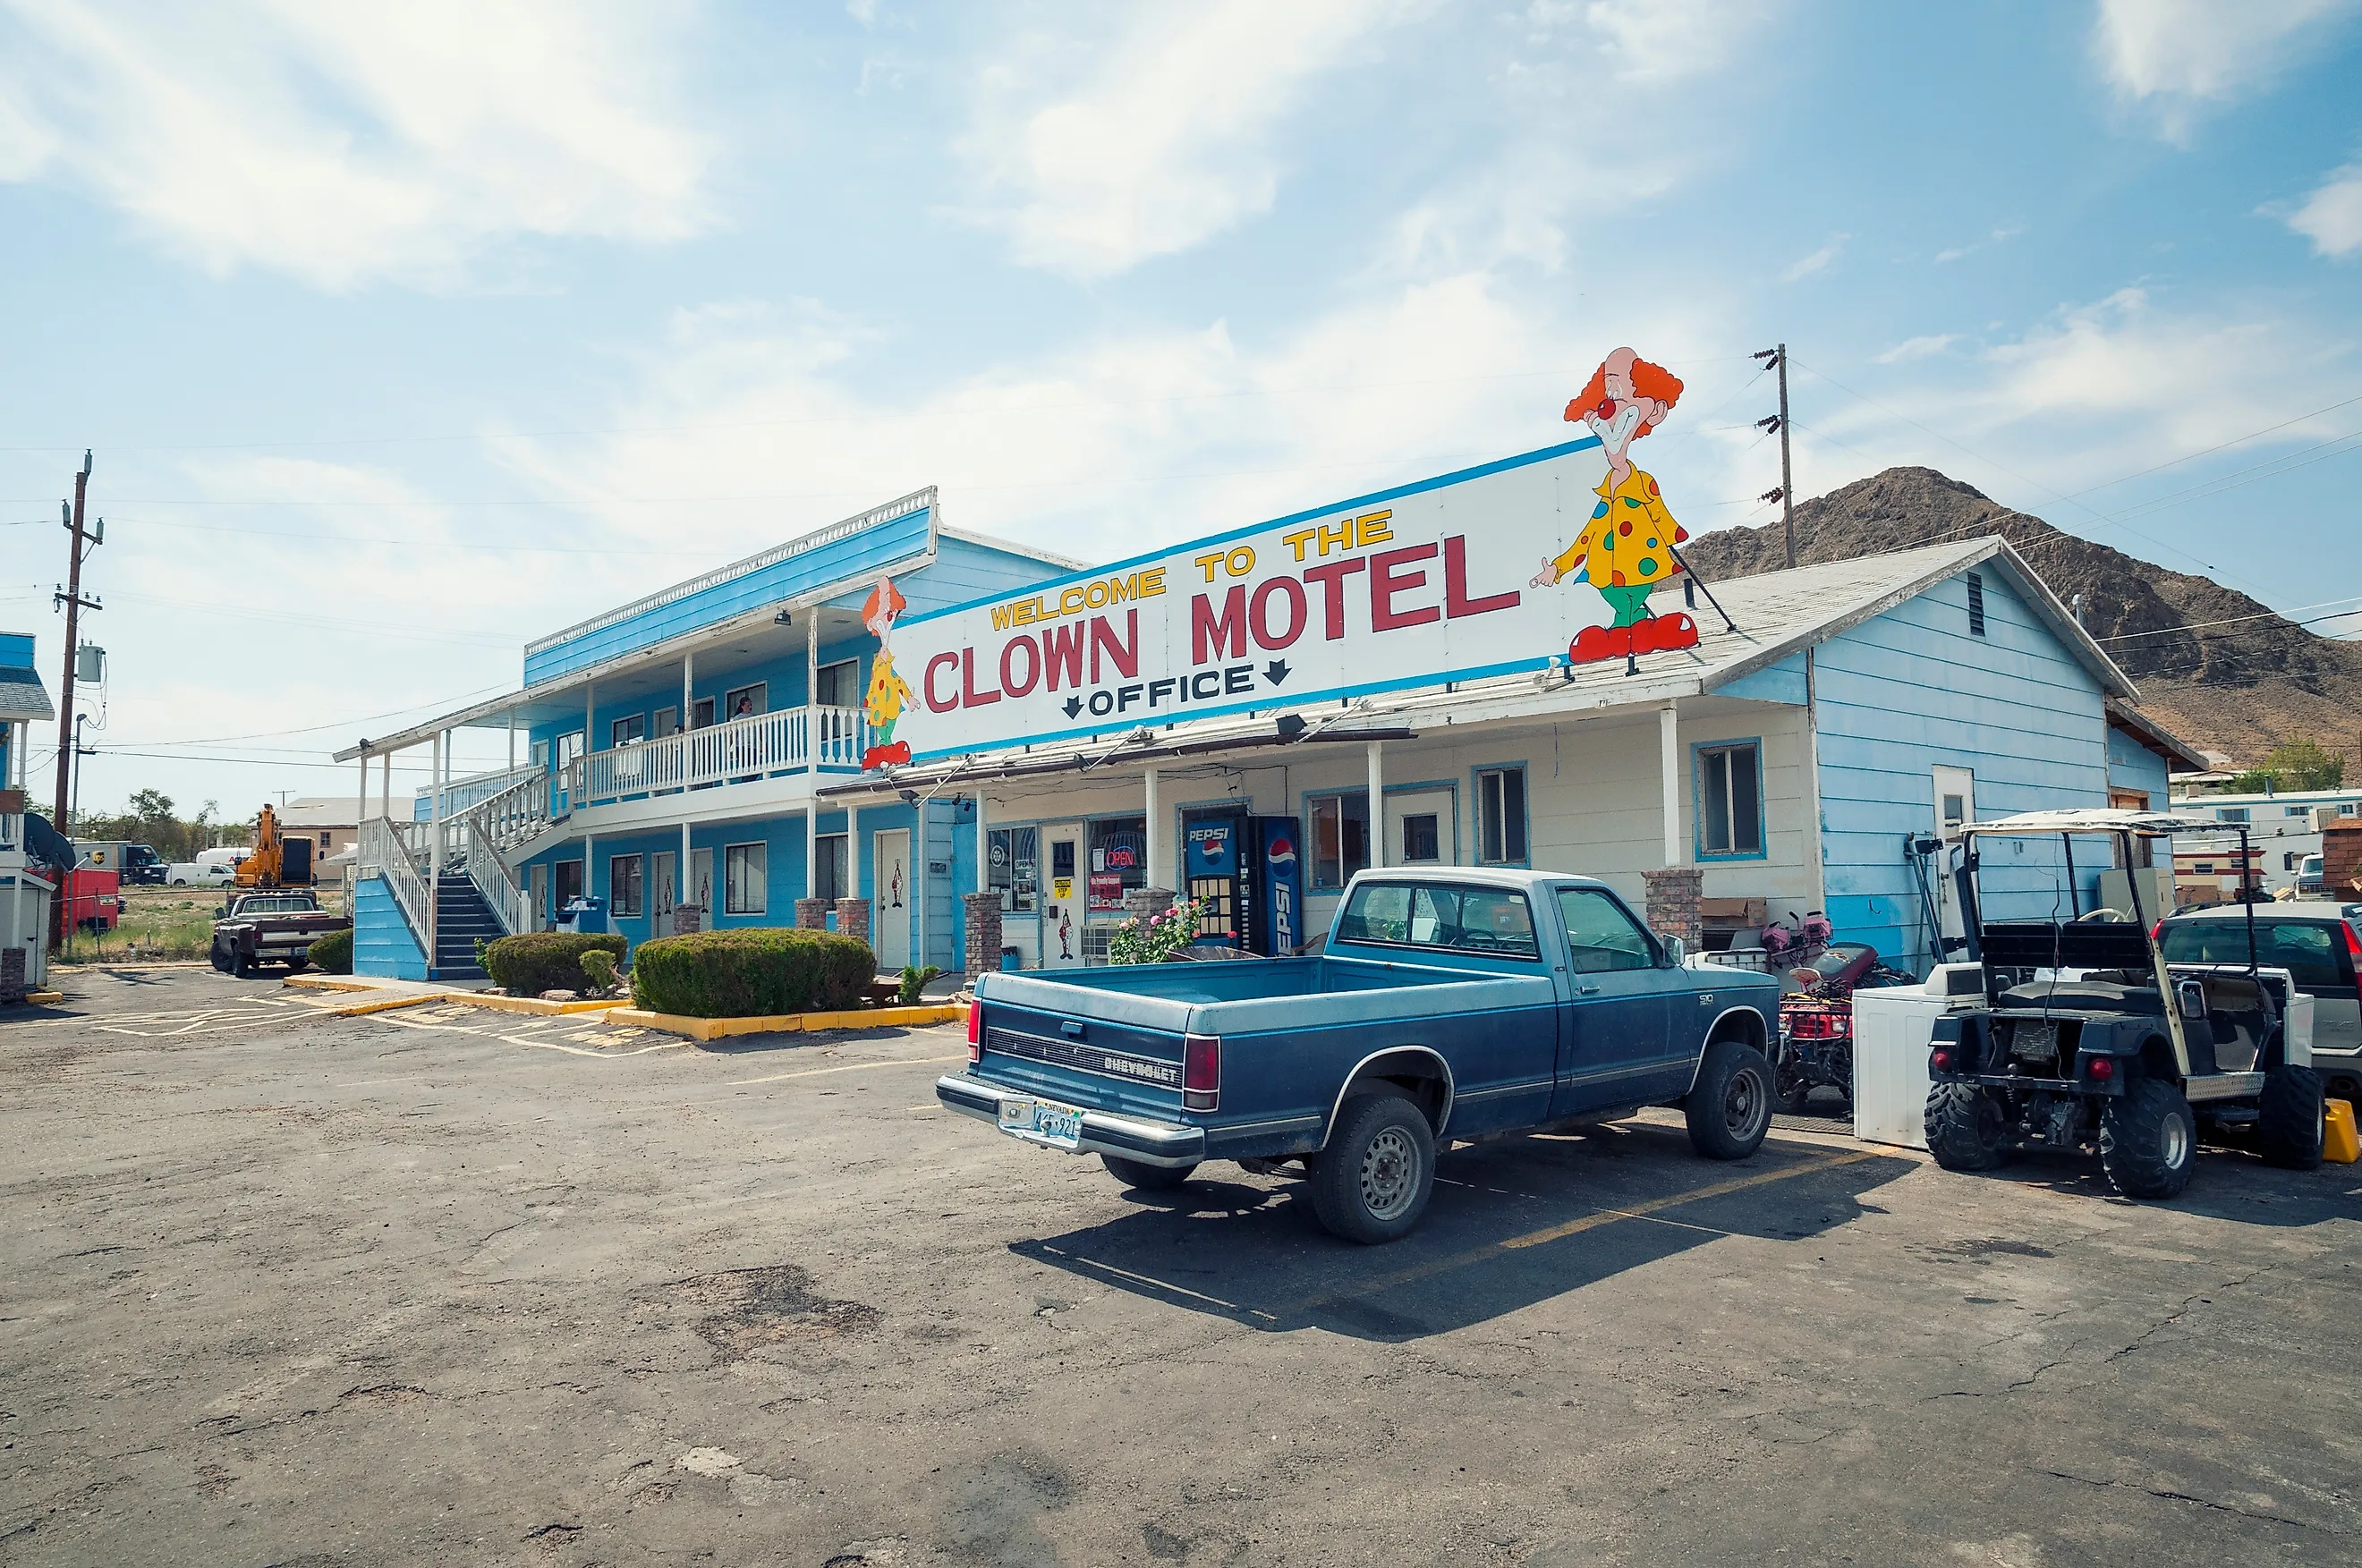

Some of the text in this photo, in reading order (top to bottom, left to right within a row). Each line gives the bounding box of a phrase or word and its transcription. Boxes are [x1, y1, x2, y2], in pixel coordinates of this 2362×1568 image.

[990, 509, 1394, 631] WELCOME TO THE
[923, 534, 1521, 714] CLOWN MOTEL
[1088, 664, 1255, 716] OFFICE
[1189, 827, 1229, 842] PEPSI
[1107, 851, 1134, 866] OPEN
[1049, 1103, 1069, 1115] NEVADA
